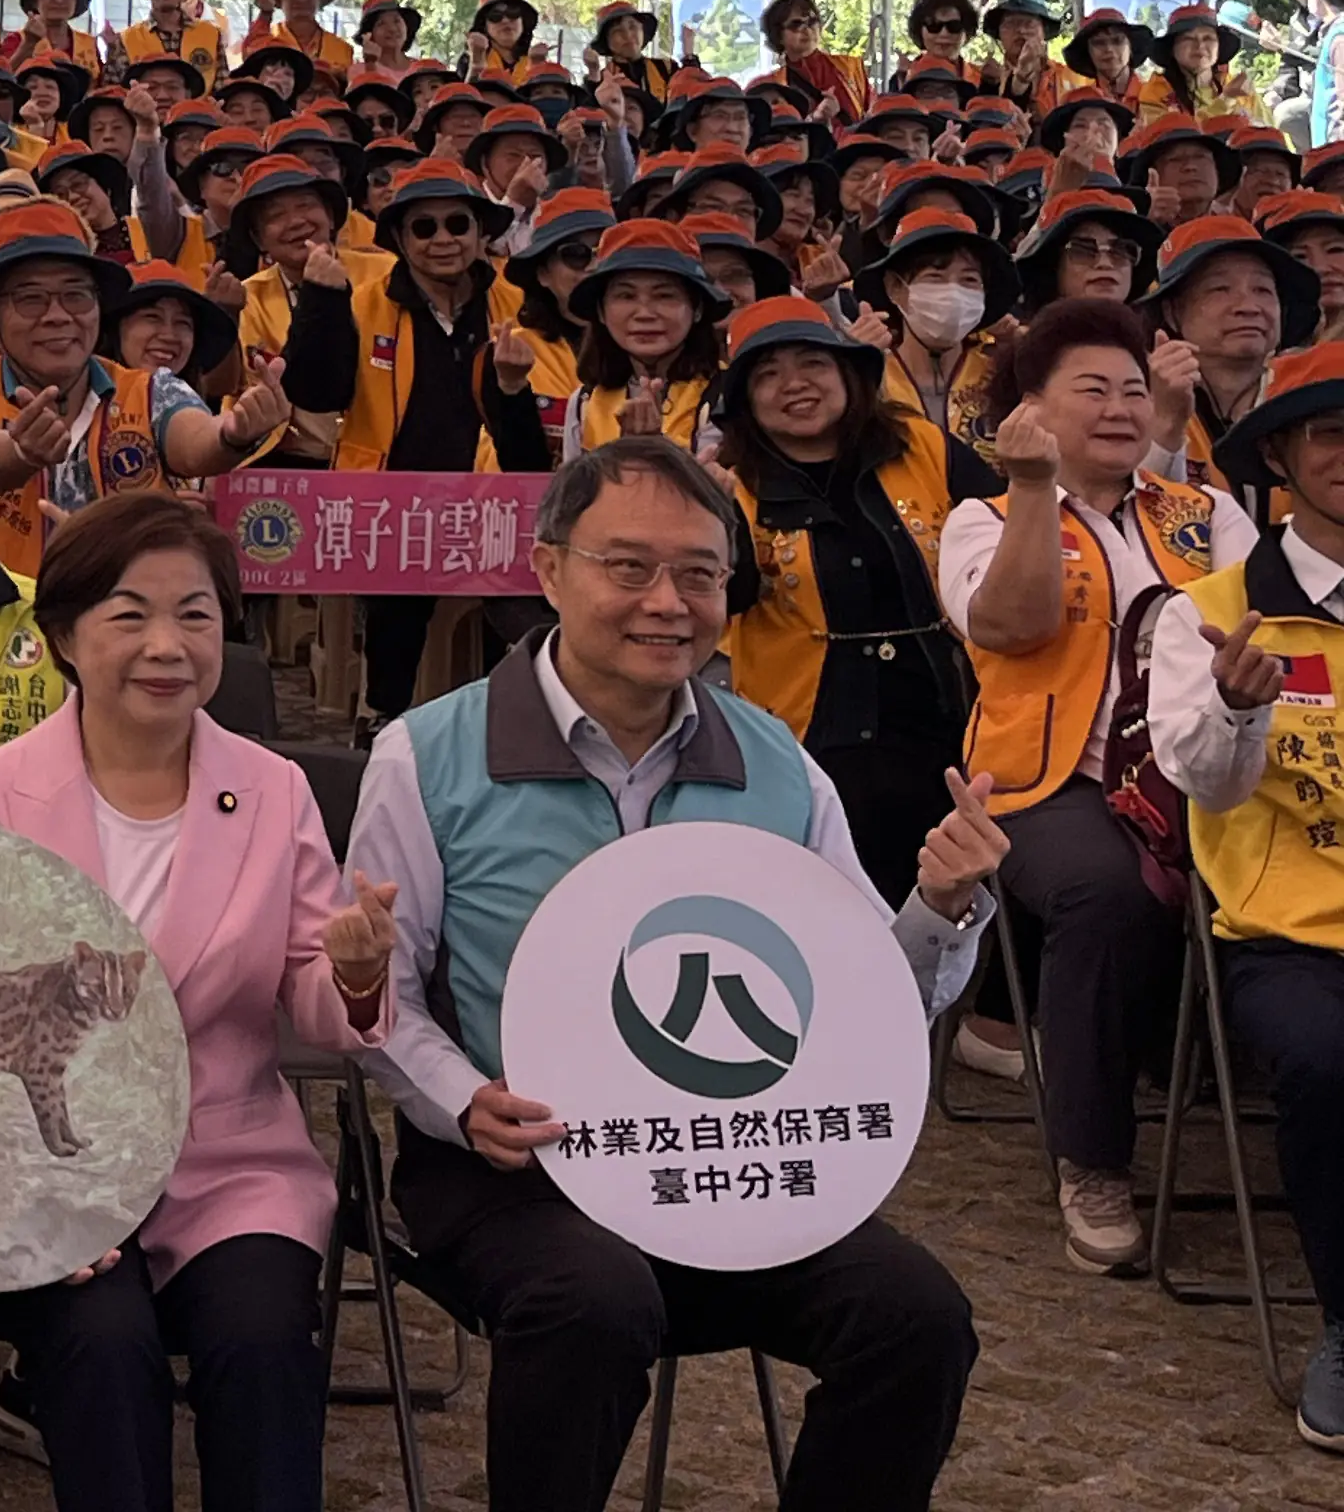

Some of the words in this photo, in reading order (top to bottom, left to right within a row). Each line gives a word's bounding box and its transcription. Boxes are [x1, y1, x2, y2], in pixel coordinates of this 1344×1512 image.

[26, 673, 48, 728] 台中
[558, 1102, 894, 1159] 林業及自然保育署
[648, 1159, 817, 1206] 臺中分署
